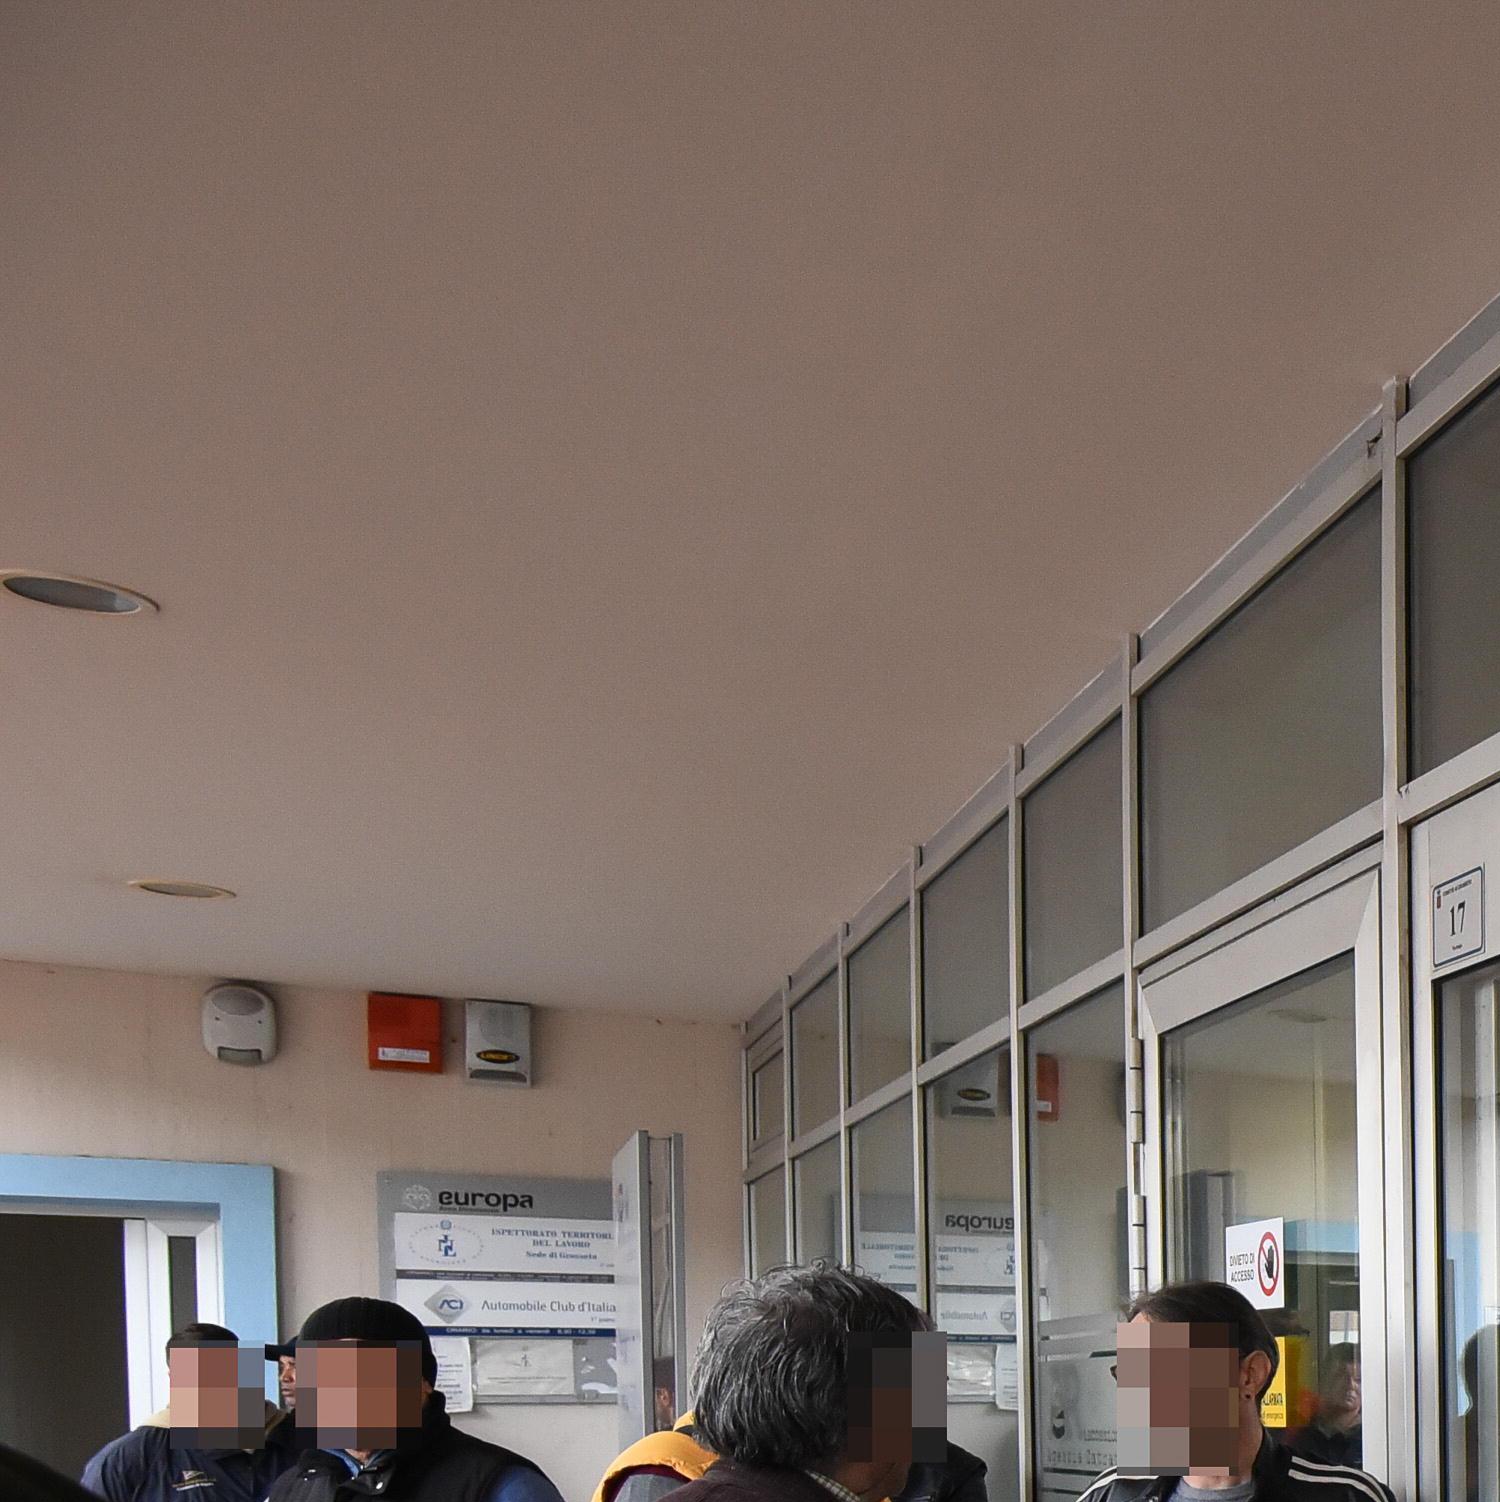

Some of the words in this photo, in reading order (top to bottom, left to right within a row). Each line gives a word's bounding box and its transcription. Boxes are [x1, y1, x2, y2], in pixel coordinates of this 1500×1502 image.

[1449, 900, 1466, 936] 17
[438, 1190, 534, 1212] europa
[1229, 1253, 1248, 1267] DIVIETO
[1230, 1269, 1255, 1282] ACCESSO
[438, 1298, 464, 1311] ACI
[481, 1299, 548, 1312] Automobile
[550, 1300, 575, 1312] Club
[577, 1301, 617, 1313] d'Italia
